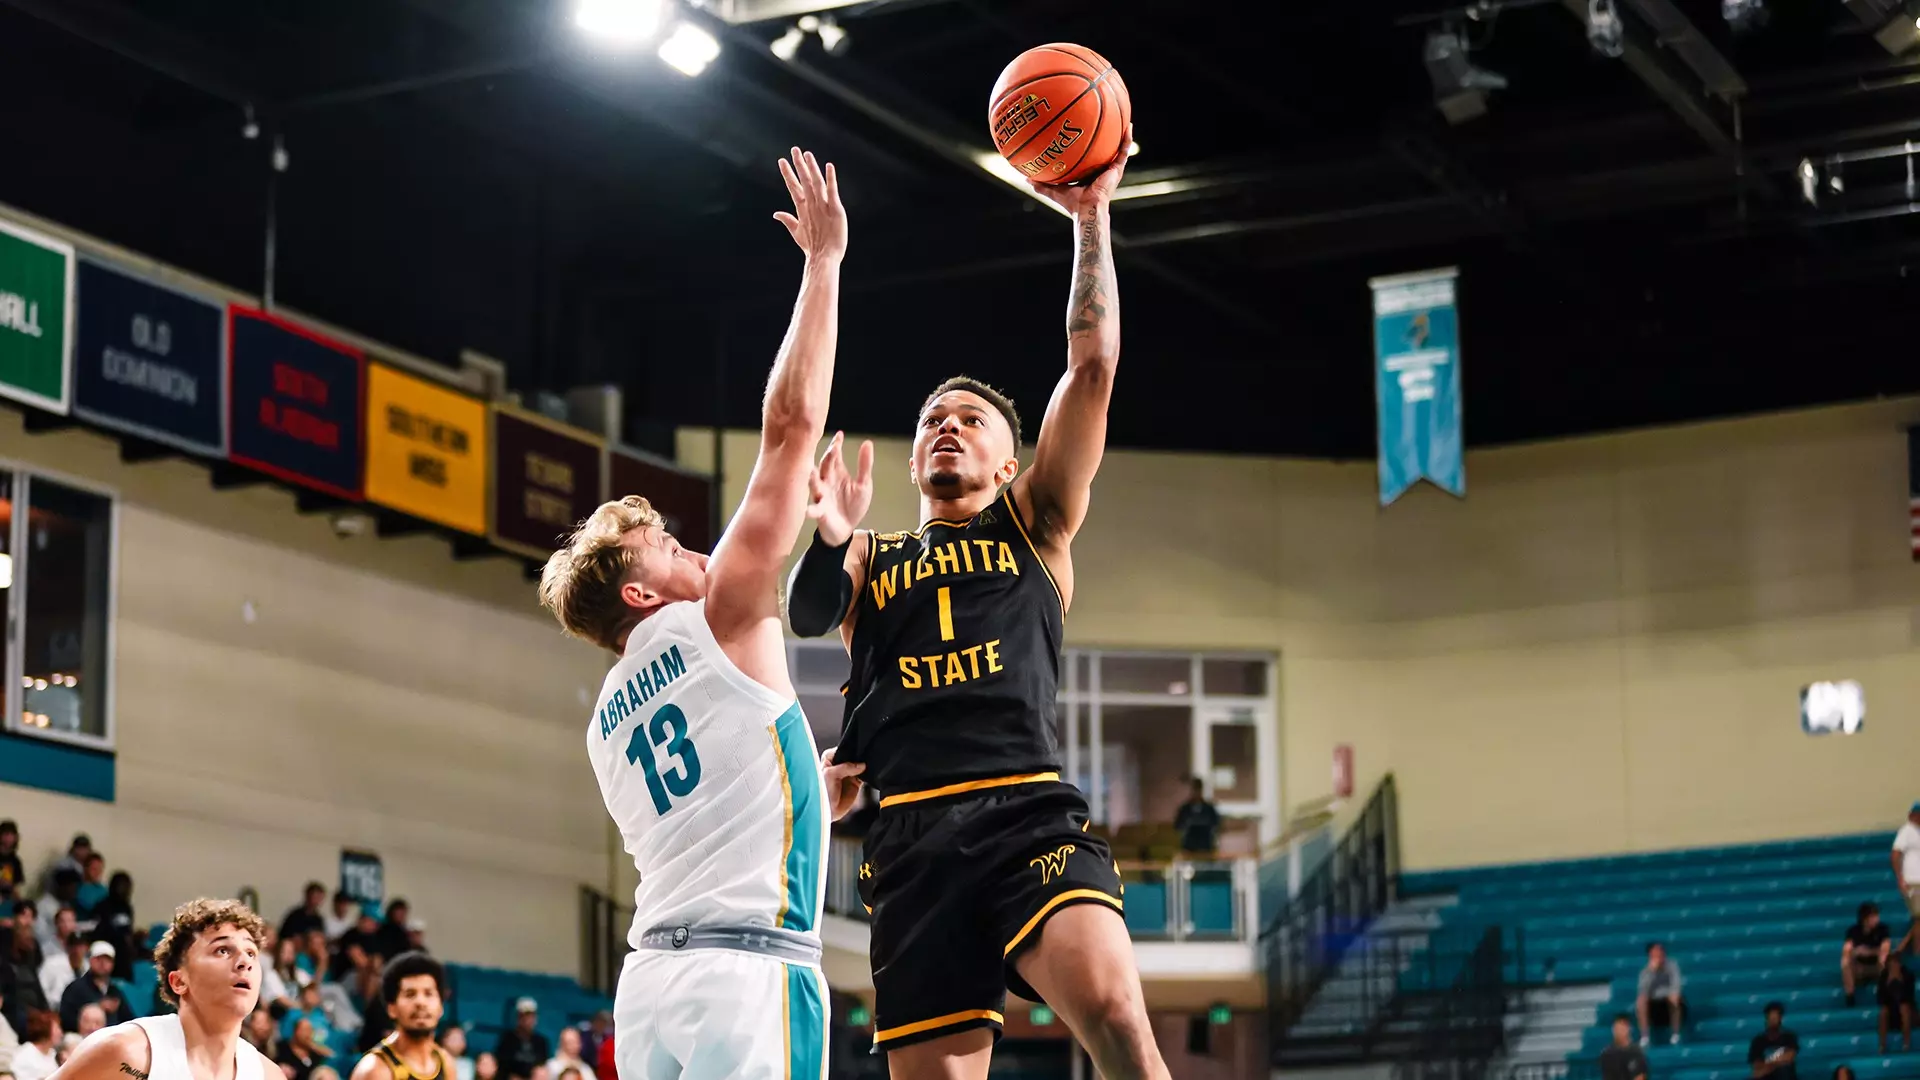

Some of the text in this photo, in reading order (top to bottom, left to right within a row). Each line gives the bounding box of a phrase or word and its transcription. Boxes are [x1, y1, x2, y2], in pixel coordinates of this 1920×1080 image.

[997, 97, 1051, 149] LEGACY
[871, 539, 1020, 611] WICHITA
[937, 586, 955, 642] 1
[600, 644, 687, 740] ABRAHAM
[898, 638, 1004, 689] STATE
[625, 703, 701, 816] 13
